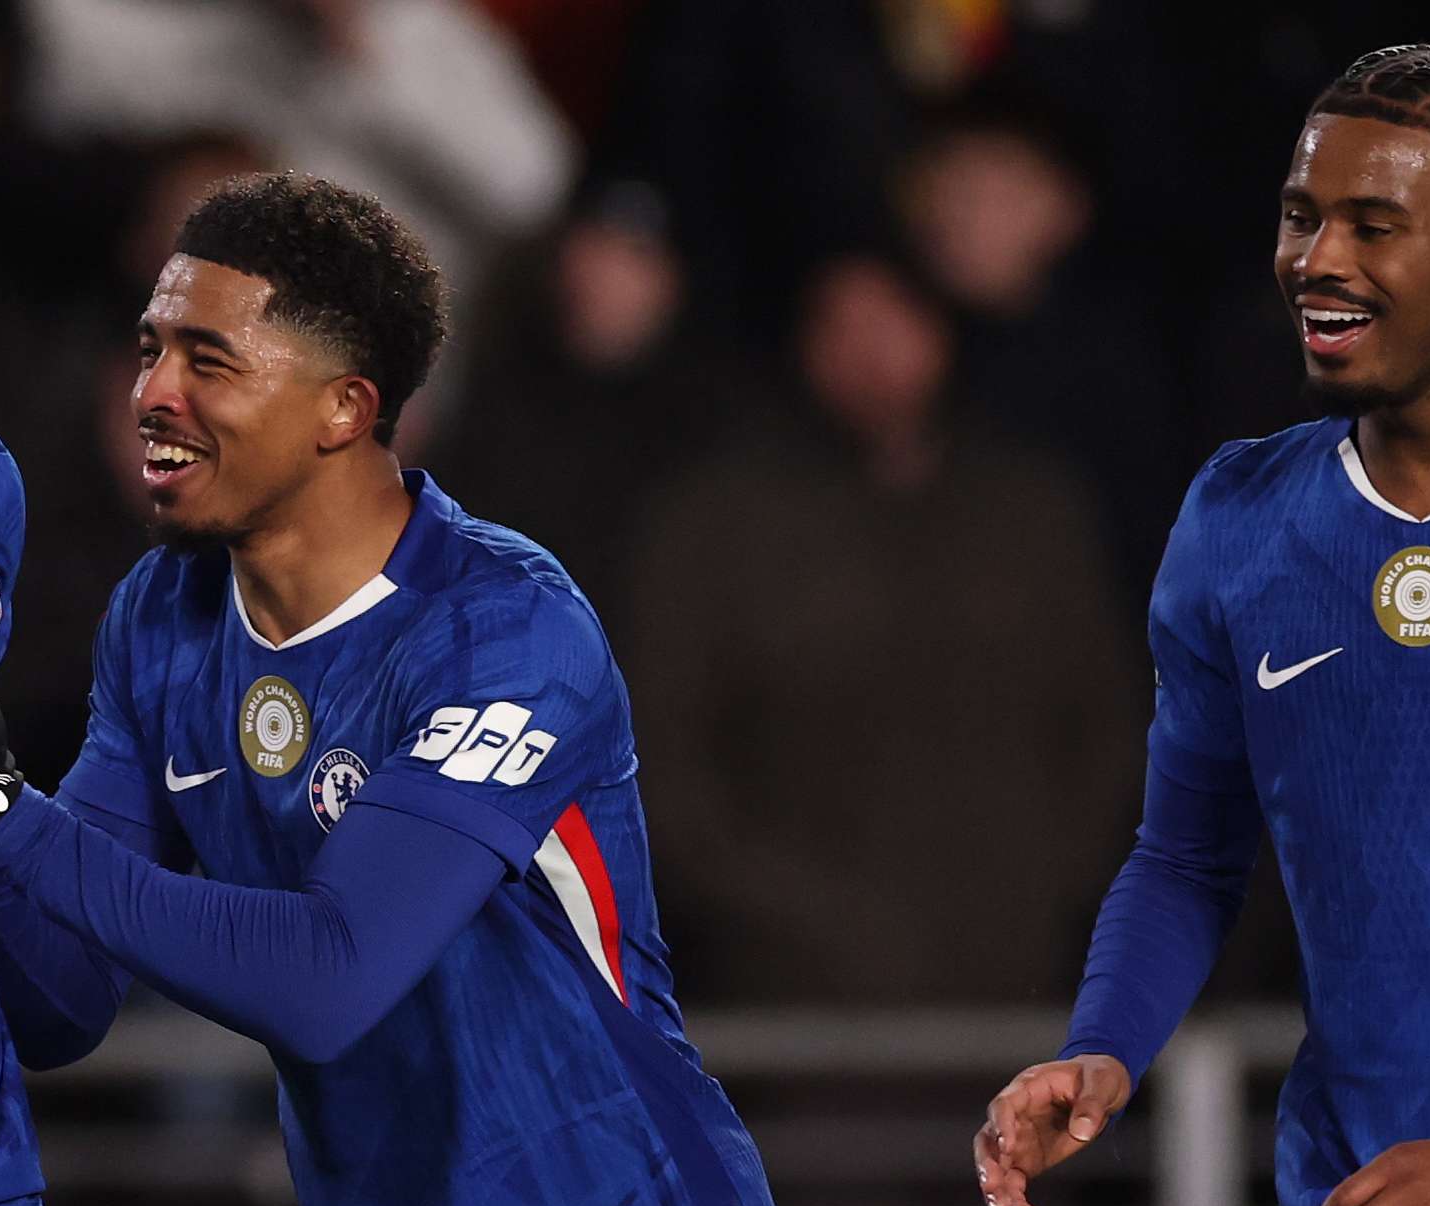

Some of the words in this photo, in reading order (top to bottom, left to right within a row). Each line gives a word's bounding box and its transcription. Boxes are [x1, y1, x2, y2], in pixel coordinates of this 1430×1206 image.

[1379, 562, 1404, 607] WORLD
[245, 689, 265, 733] WORLD
[265, 685, 305, 743] CHAMPIONS
[257, 752, 284, 769] FIFA
[320, 753, 362, 773] CHELSEA
